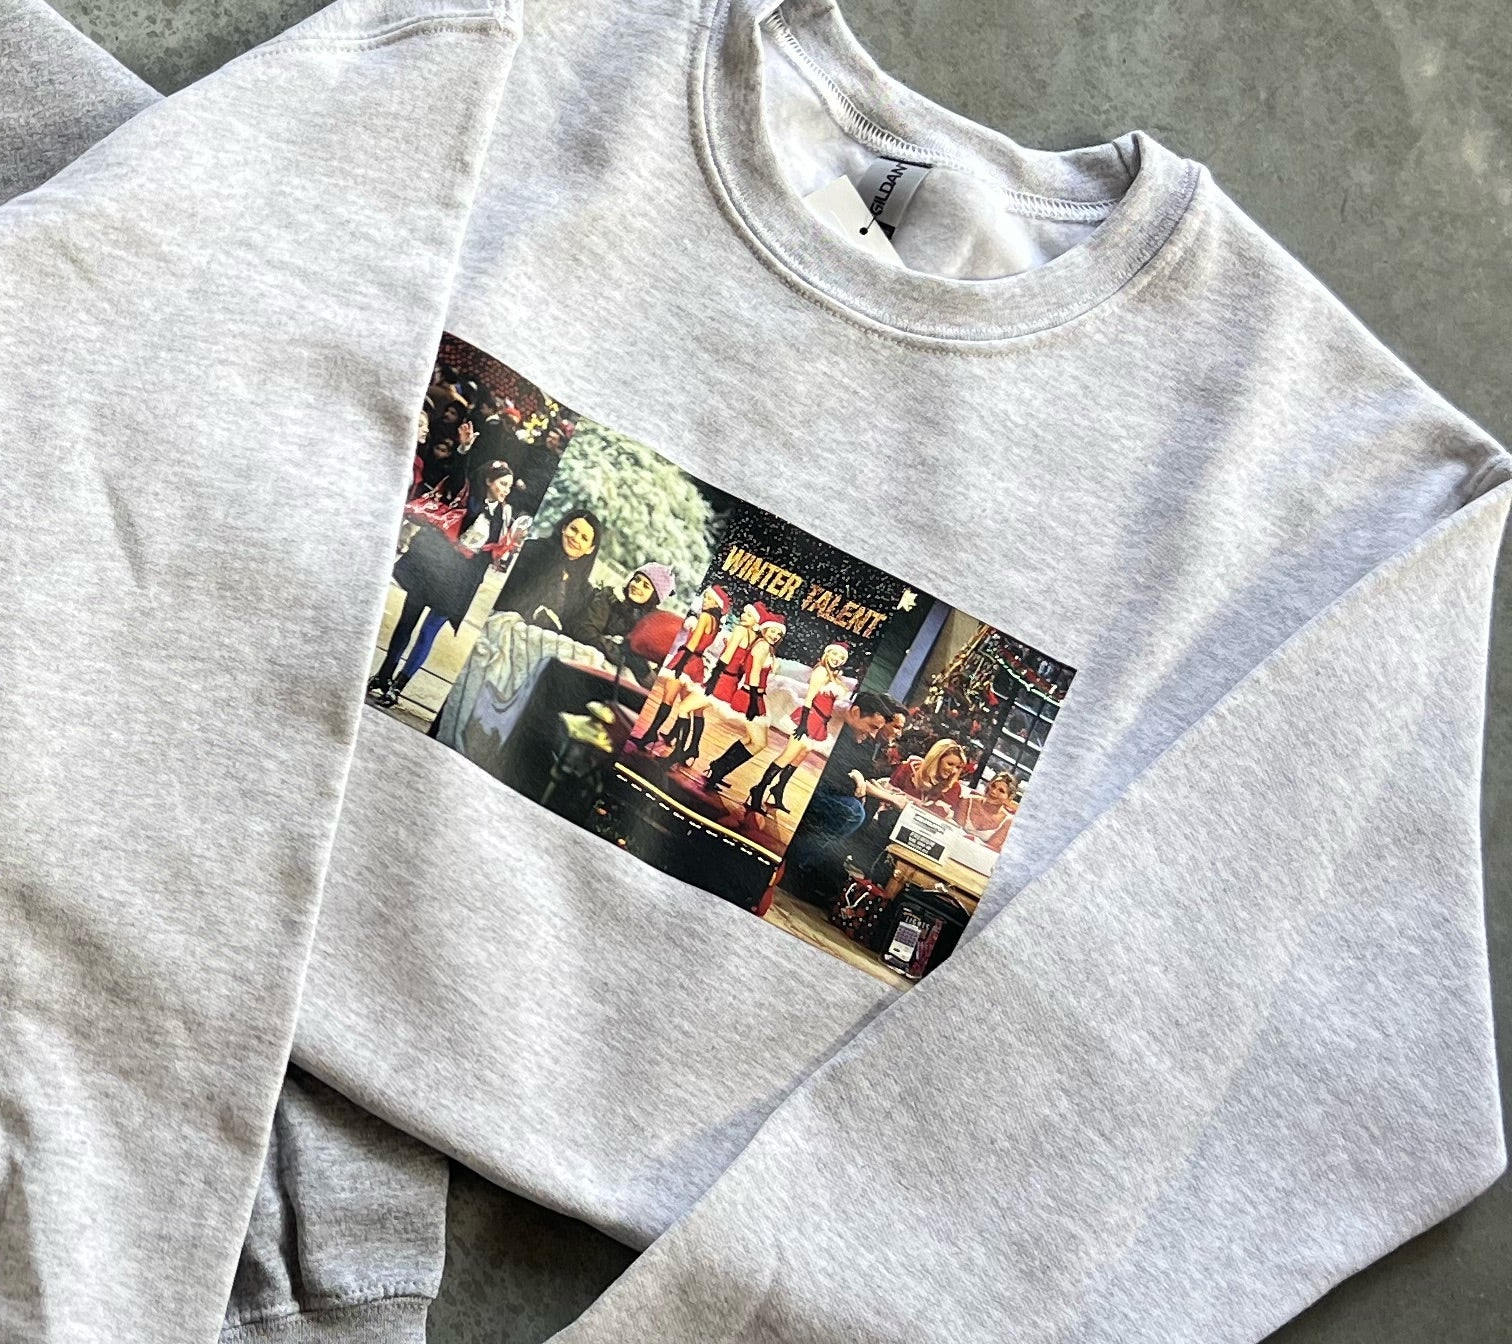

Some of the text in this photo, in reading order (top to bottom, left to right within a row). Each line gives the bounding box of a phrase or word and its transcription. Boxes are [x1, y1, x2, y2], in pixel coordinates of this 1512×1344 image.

[870, 162, 908, 216] GILDAN
[722, 545, 888, 639] WINTER TALENT
